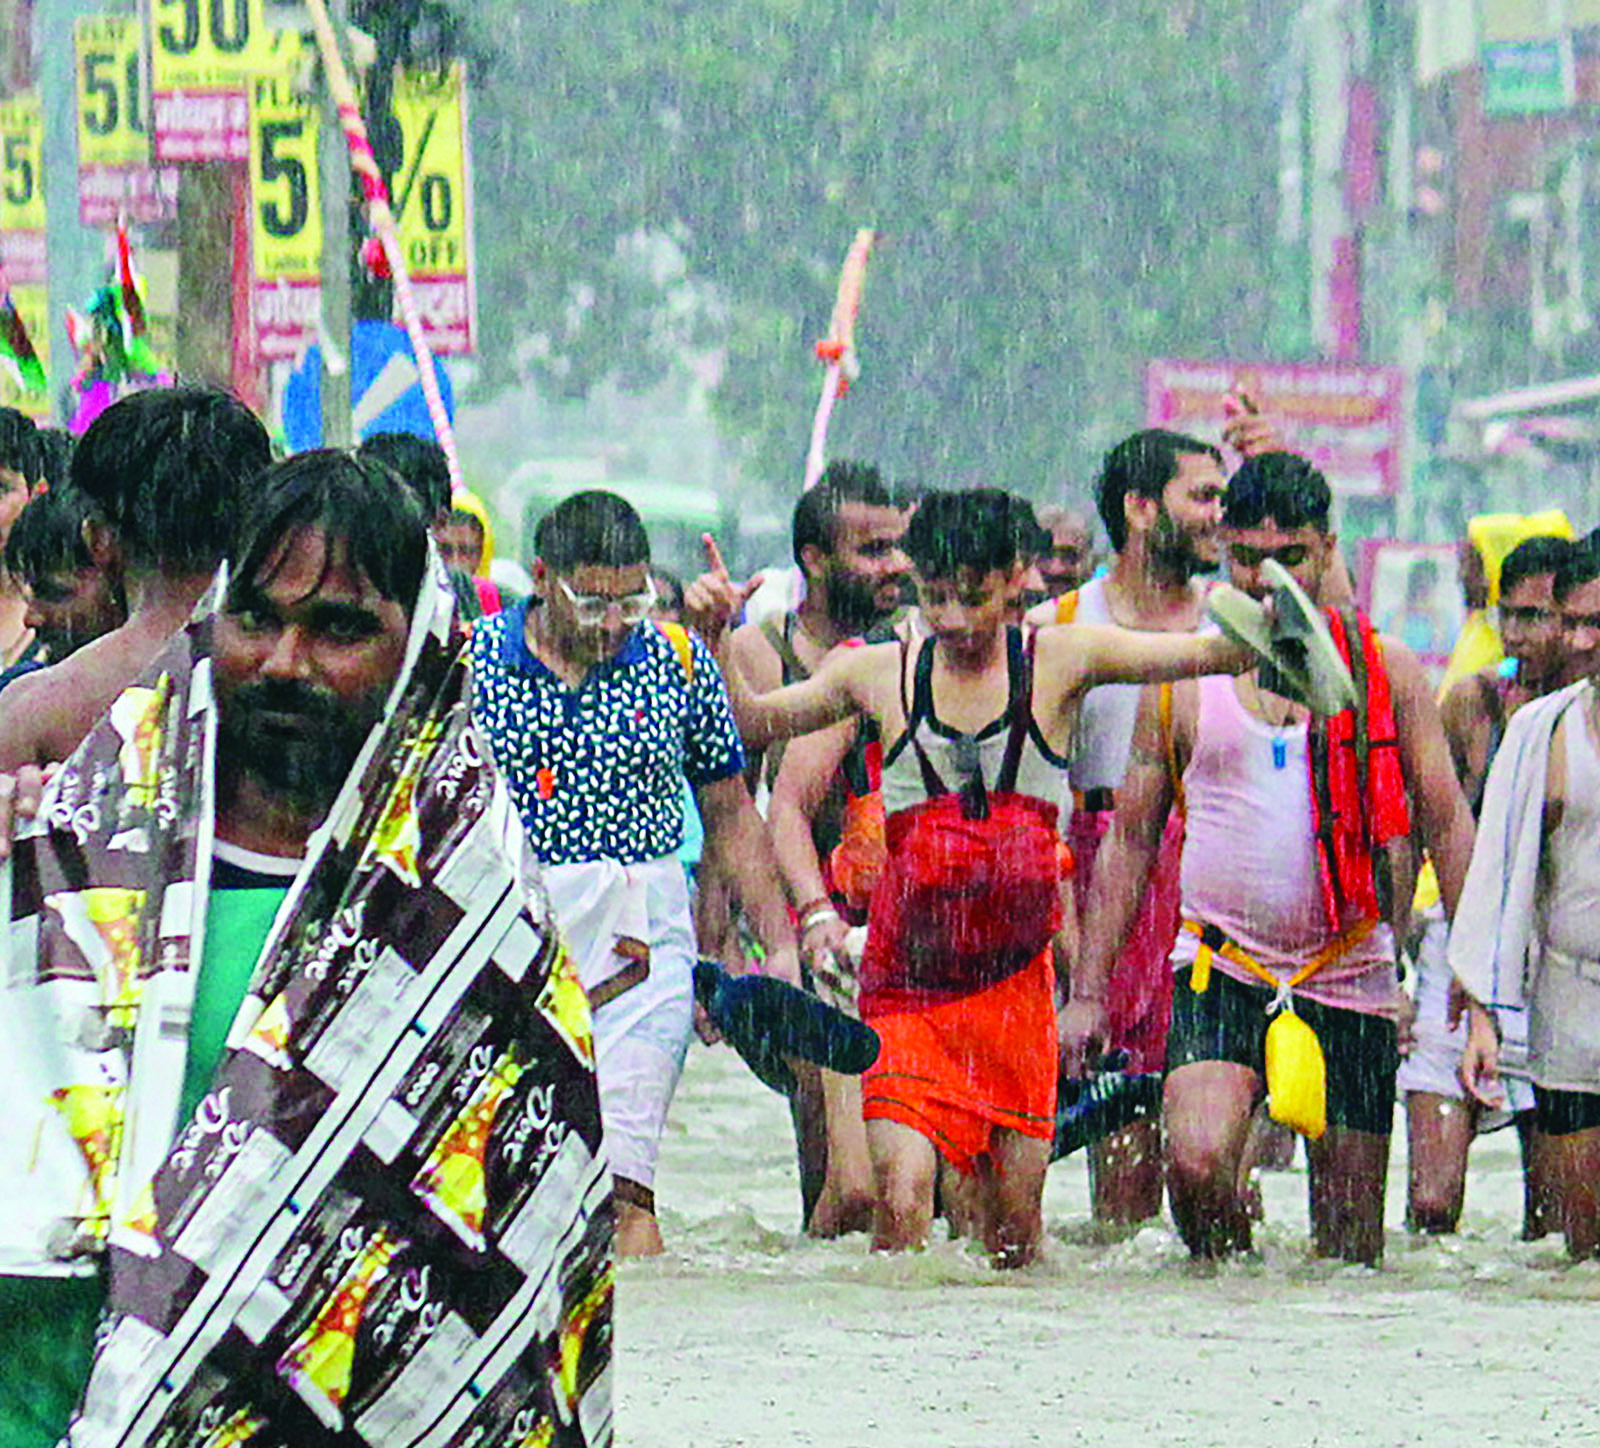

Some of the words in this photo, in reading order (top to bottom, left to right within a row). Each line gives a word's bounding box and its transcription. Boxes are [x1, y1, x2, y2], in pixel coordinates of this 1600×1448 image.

[170, 1085, 232, 1172] Dove
[502, 1084, 556, 1163] Dove
[373, 1265, 433, 1346] Dove
